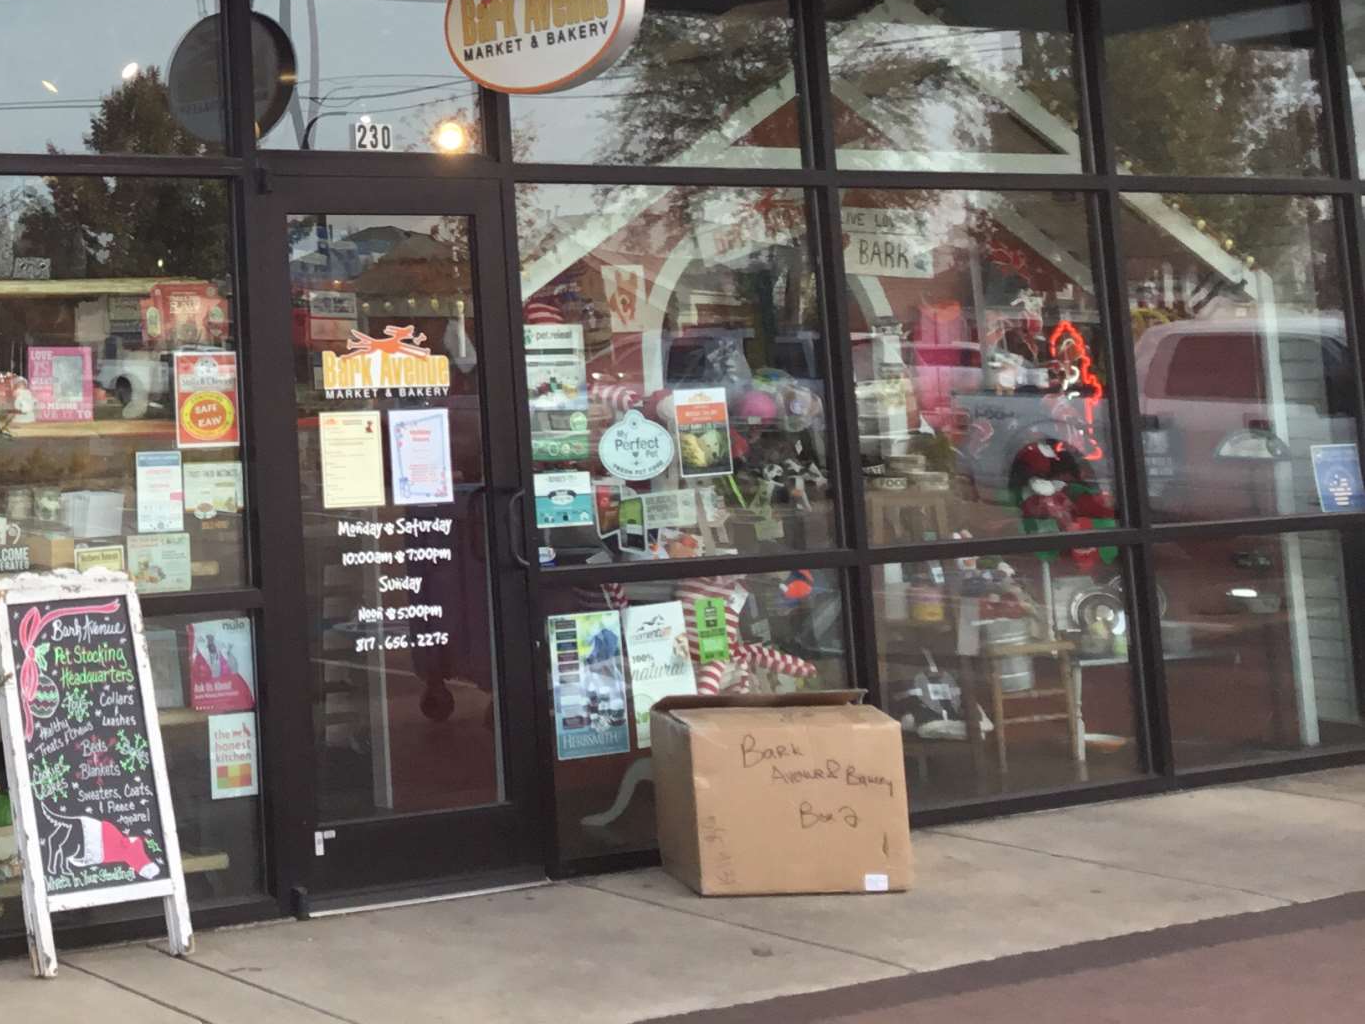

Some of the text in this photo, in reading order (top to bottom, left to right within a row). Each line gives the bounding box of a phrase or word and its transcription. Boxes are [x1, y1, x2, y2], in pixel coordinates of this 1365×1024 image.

[463, 21, 609, 62] MARKET & BAKERY
[357, 124, 391, 150] 230
[858, 238, 909, 269] BARK
[322, 351, 450, 388] Bark Avenue
[324, 387, 450, 400] MARKET & BAKERY
[614, 436, 660, 451] Perfect
[337, 518, 453, 539] Monday Saturday
[341, 547, 452, 566] 10:00am 7:00pm
[378, 576, 423, 594] Sunday
[357, 605, 443, 622] Noon 5:00pm
[50, 614, 127, 643] Bark Avenue
[54, 643, 128, 668] Pet Stocking
[60, 666, 134, 690] Headquarters
[632, 661, 685, 681] natural
[99, 691, 134, 707] Collars
[102, 715, 137, 727] Leashes
[214, 729, 231, 741] the
[34, 737, 65, 755] Treats
[80, 739, 109, 757] Beds
[215, 740, 251, 752] honest
[215, 751, 252, 763] kitchen
[78, 762, 122, 780] Blankets
